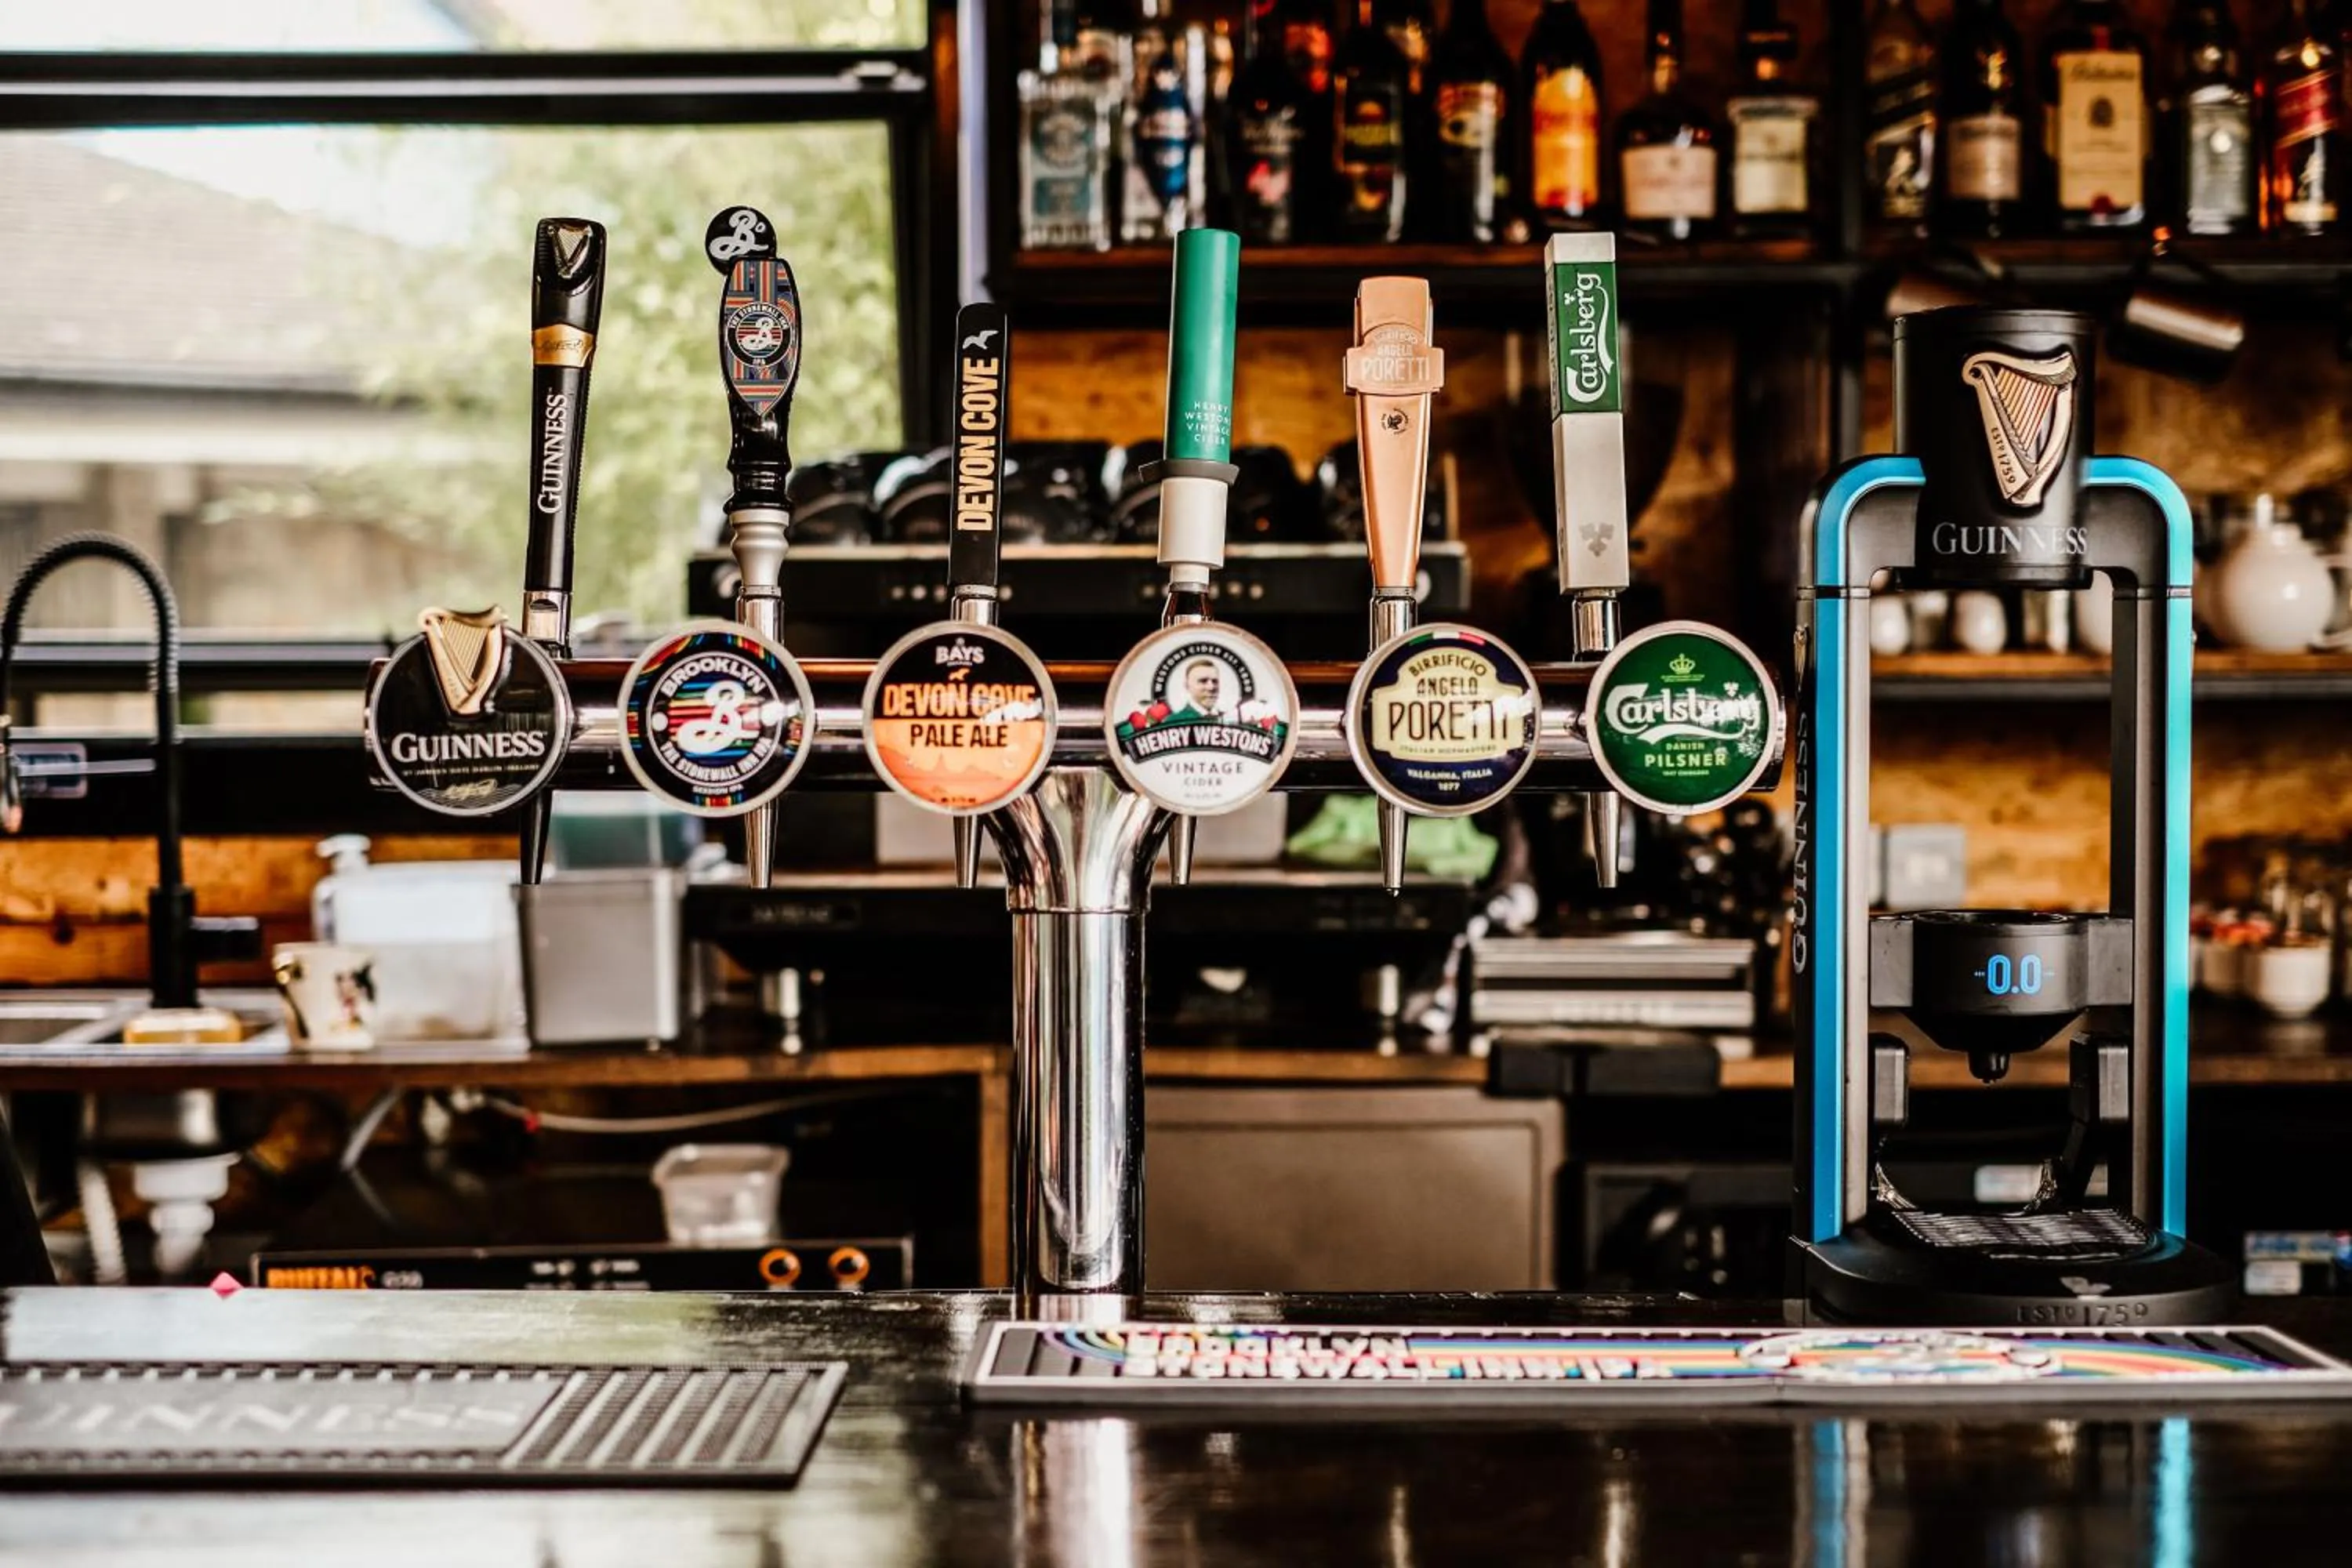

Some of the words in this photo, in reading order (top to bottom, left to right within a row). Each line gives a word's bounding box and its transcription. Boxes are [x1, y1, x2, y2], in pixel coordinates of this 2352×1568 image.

[1566, 272, 1602, 402] Carlsberg
[1362, 357, 1430, 381] PORETTI
[960, 358, 1000, 430] COVE
[537, 394, 567, 514] GUINNESS
[1998, 454, 2016, 483] 1759
[957, 436, 996, 532] DEVON
[1933, 522, 2088, 554] GUINNESS
[935, 646, 985, 664] BAYS
[1189, 645, 1221, 654] CIDER
[661, 658, 765, 697] BROOKLYN
[1408, 654, 1487, 677] BIRRIFICIO
[883, 683, 969, 717] DEVON
[1417, 677, 1478, 696] ANGELO
[392, 731, 546, 763] GUINNESS
[910, 724, 964, 747] PALE
[970, 724, 1008, 747] ALE
[1135, 726, 1191, 757] HENRY
[1193, 726, 1272, 756] WESTONS
[1162, 761, 1243, 774] VINTAGE
[1644, 753, 1726, 768] PILSNER
[1184, 777, 1222, 786] CIDER
[1987, 954, 2042, 995] 0.0
